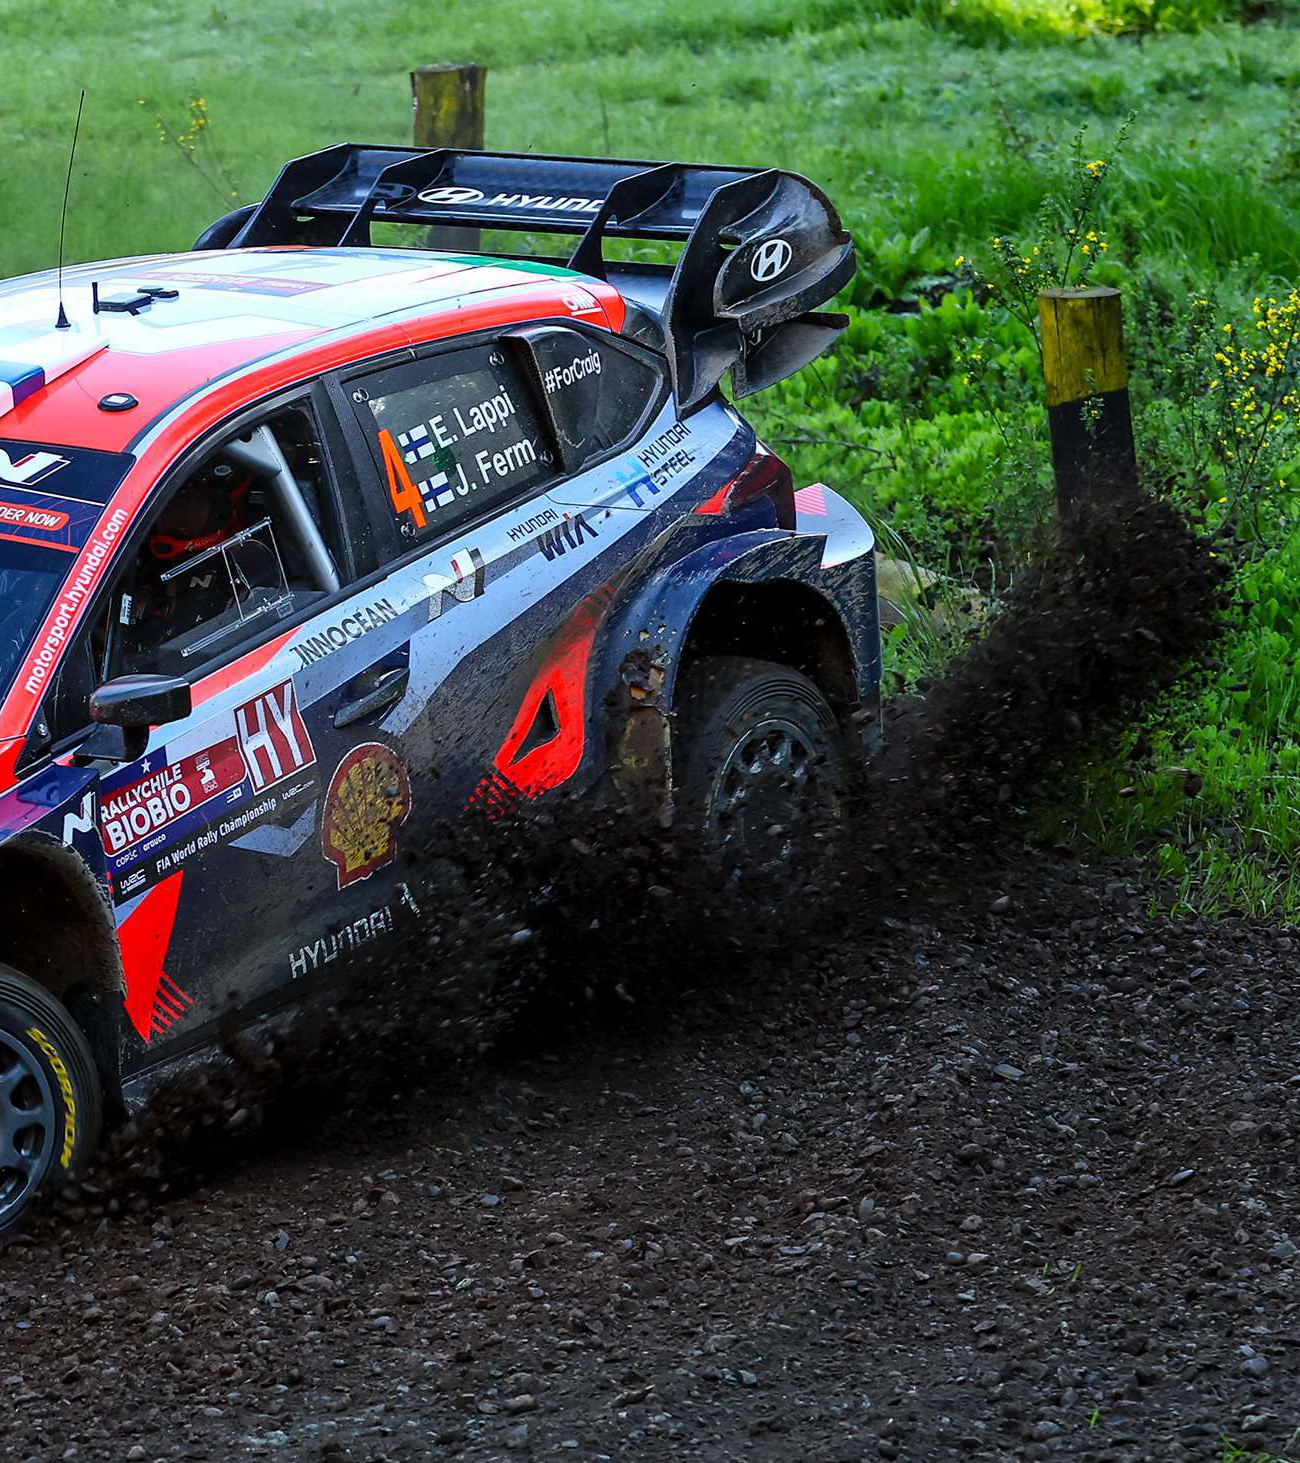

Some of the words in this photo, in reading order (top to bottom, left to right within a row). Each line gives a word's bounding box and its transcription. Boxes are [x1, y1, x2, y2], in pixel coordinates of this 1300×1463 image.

[545, 349, 601, 394] #ForCraig
[429, 415, 458, 449] E.
[453, 385, 515, 438] Lappi
[637, 422, 691, 467] HYUNDAI
[455, 463, 477, 496] J.
[475, 437, 536, 484] Ferm
[651, 449, 696, 486] STEEL
[24, 510, 62, 528] NOW
[506, 508, 559, 541] HYUNDAI
[25, 508, 129, 695] motorsport.hyundai.com
[237, 682, 303, 788] HY
[101, 763, 182, 822] RALLYCHILE
[156, 856, 171, 873] FIA
[171, 842, 196, 865] World
[197, 830, 218, 850] Rally
[219, 798, 276, 836] Championship
[288, 906, 393, 979] HYUNDAI
